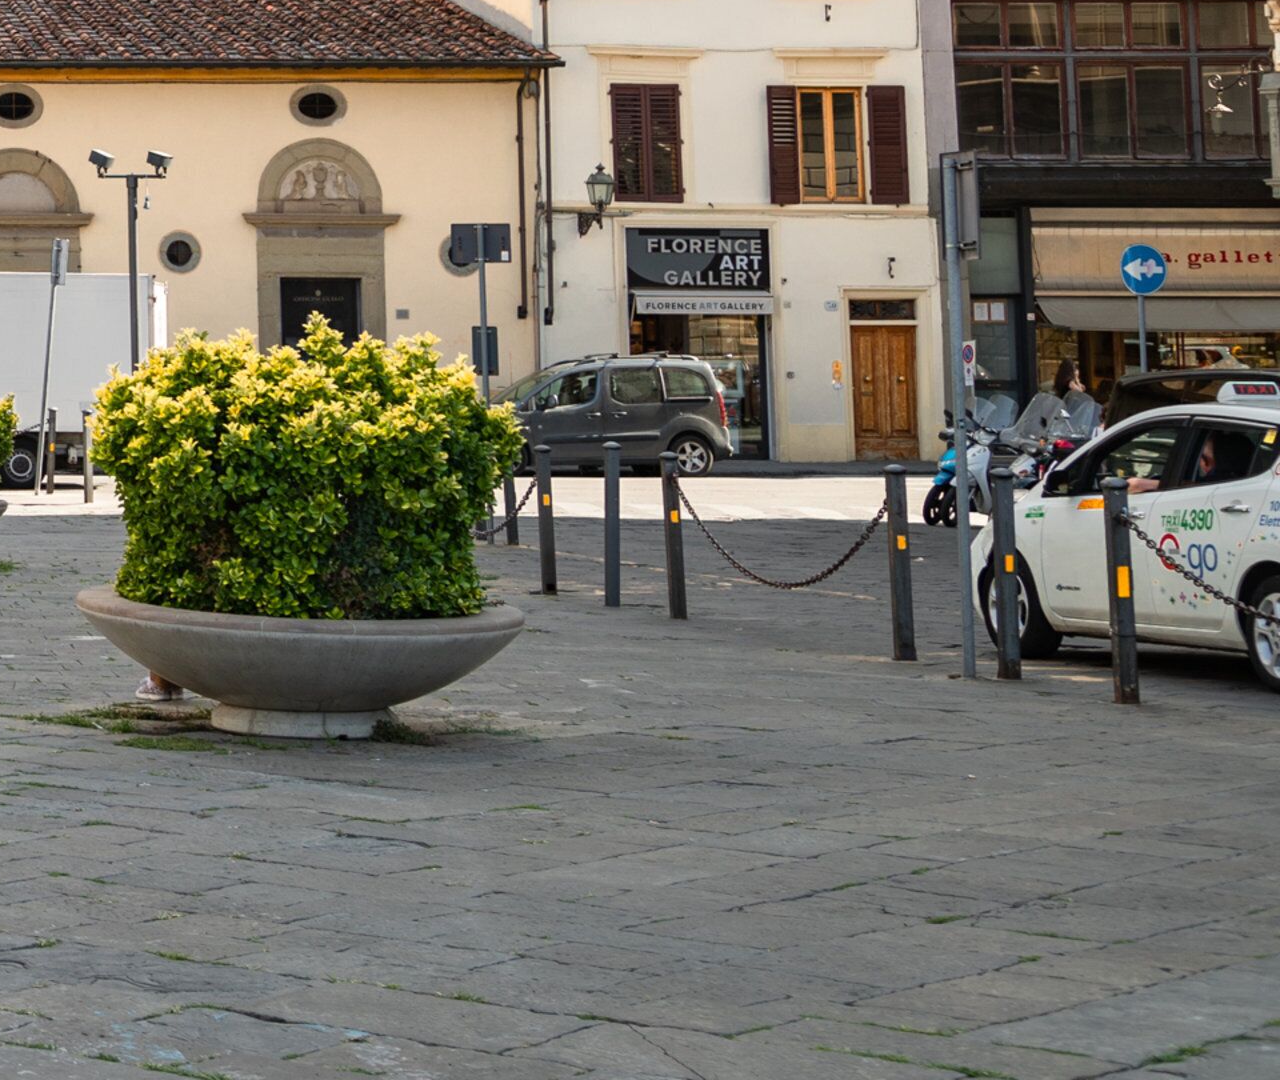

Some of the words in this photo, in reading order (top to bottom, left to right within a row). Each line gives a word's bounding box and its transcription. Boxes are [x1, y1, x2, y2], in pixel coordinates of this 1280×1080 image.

[646, 238, 762, 254] FLORENCE
[719, 255, 762, 270] ART
[1187, 250, 1280, 269] gallet
[663, 270, 762, 286] GALLERY
[646, 302, 697, 311] FLORENCE
[699, 302, 718, 310] ART
[720, 302, 764, 311] GALLERY
[1181, 508, 1214, 531] 4390
